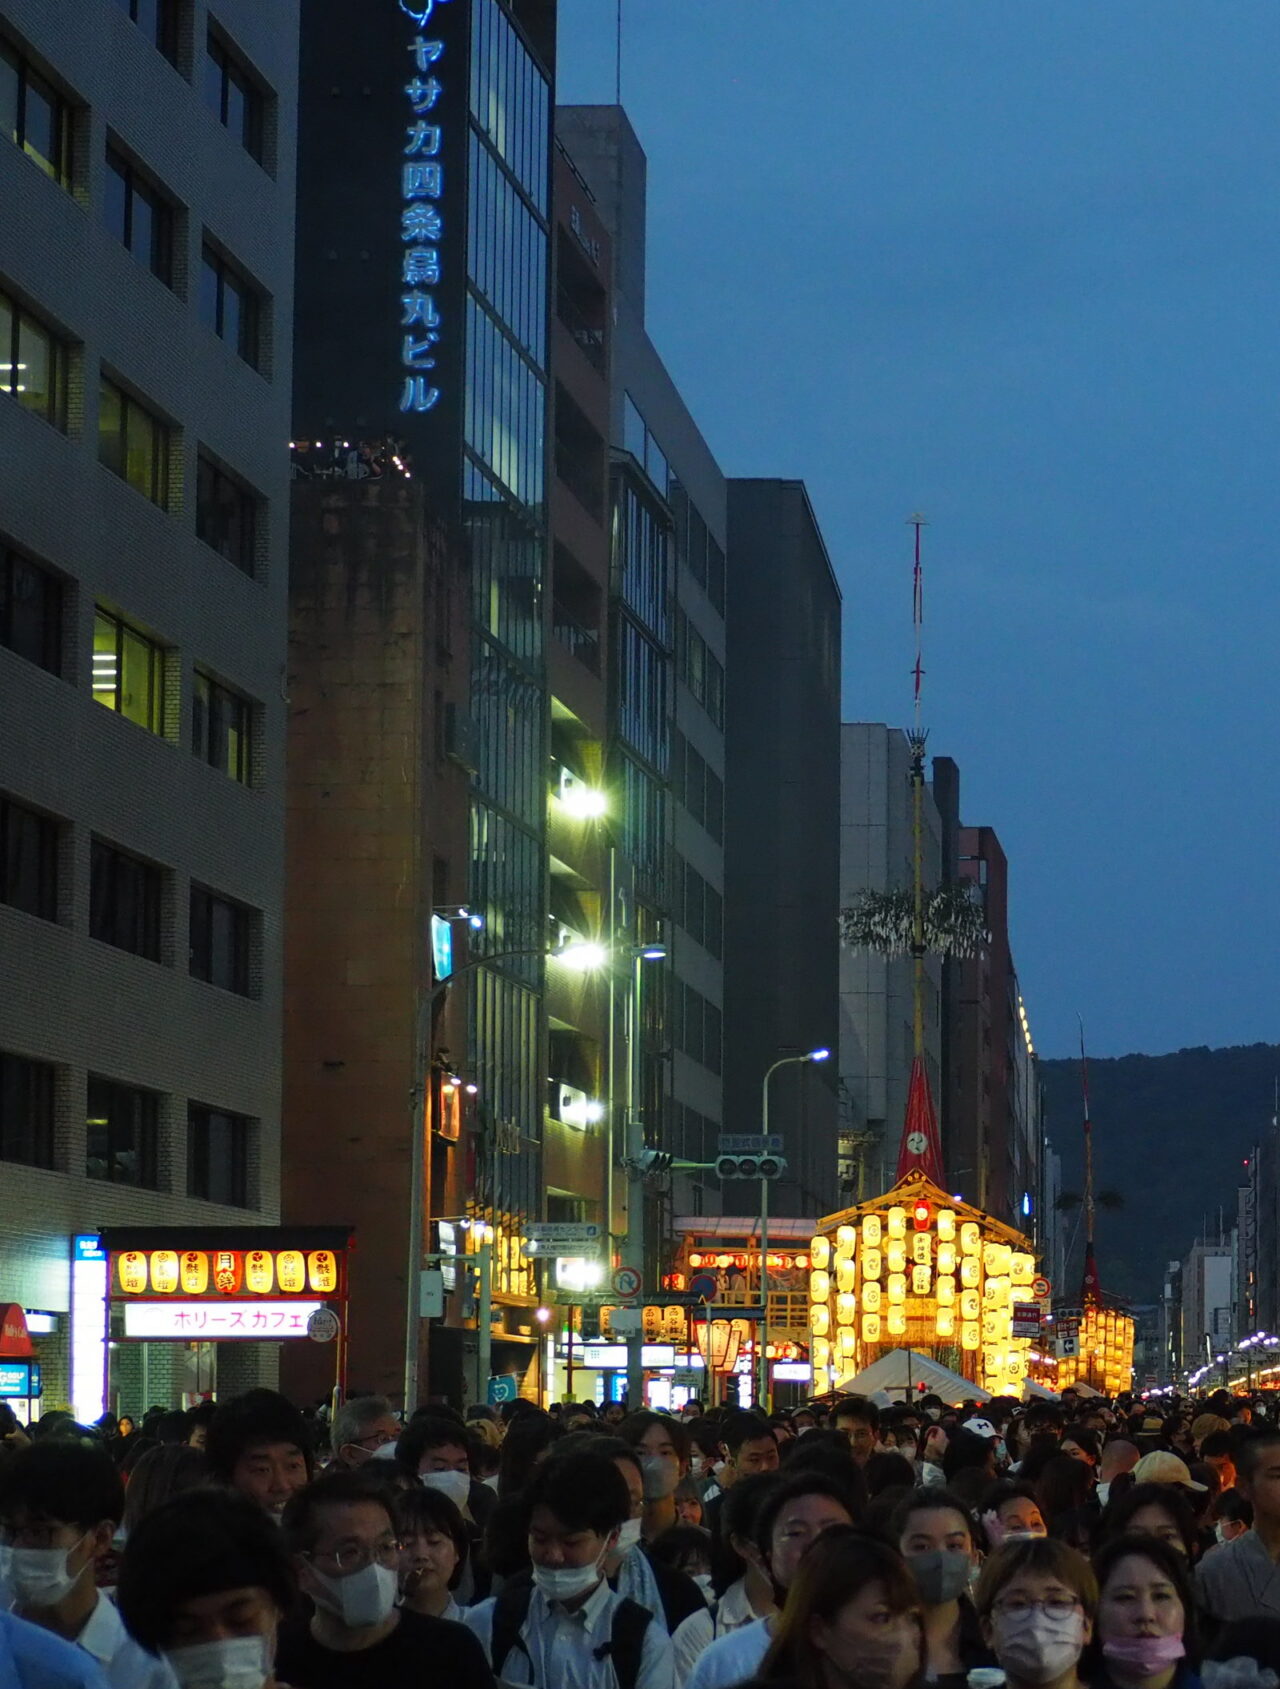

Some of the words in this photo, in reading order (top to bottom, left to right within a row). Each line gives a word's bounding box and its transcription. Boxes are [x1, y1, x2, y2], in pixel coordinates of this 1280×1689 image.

[217, 1253, 236, 1290] 月鉾
[174, 1310, 304, 1329] ホリーズカフェ
